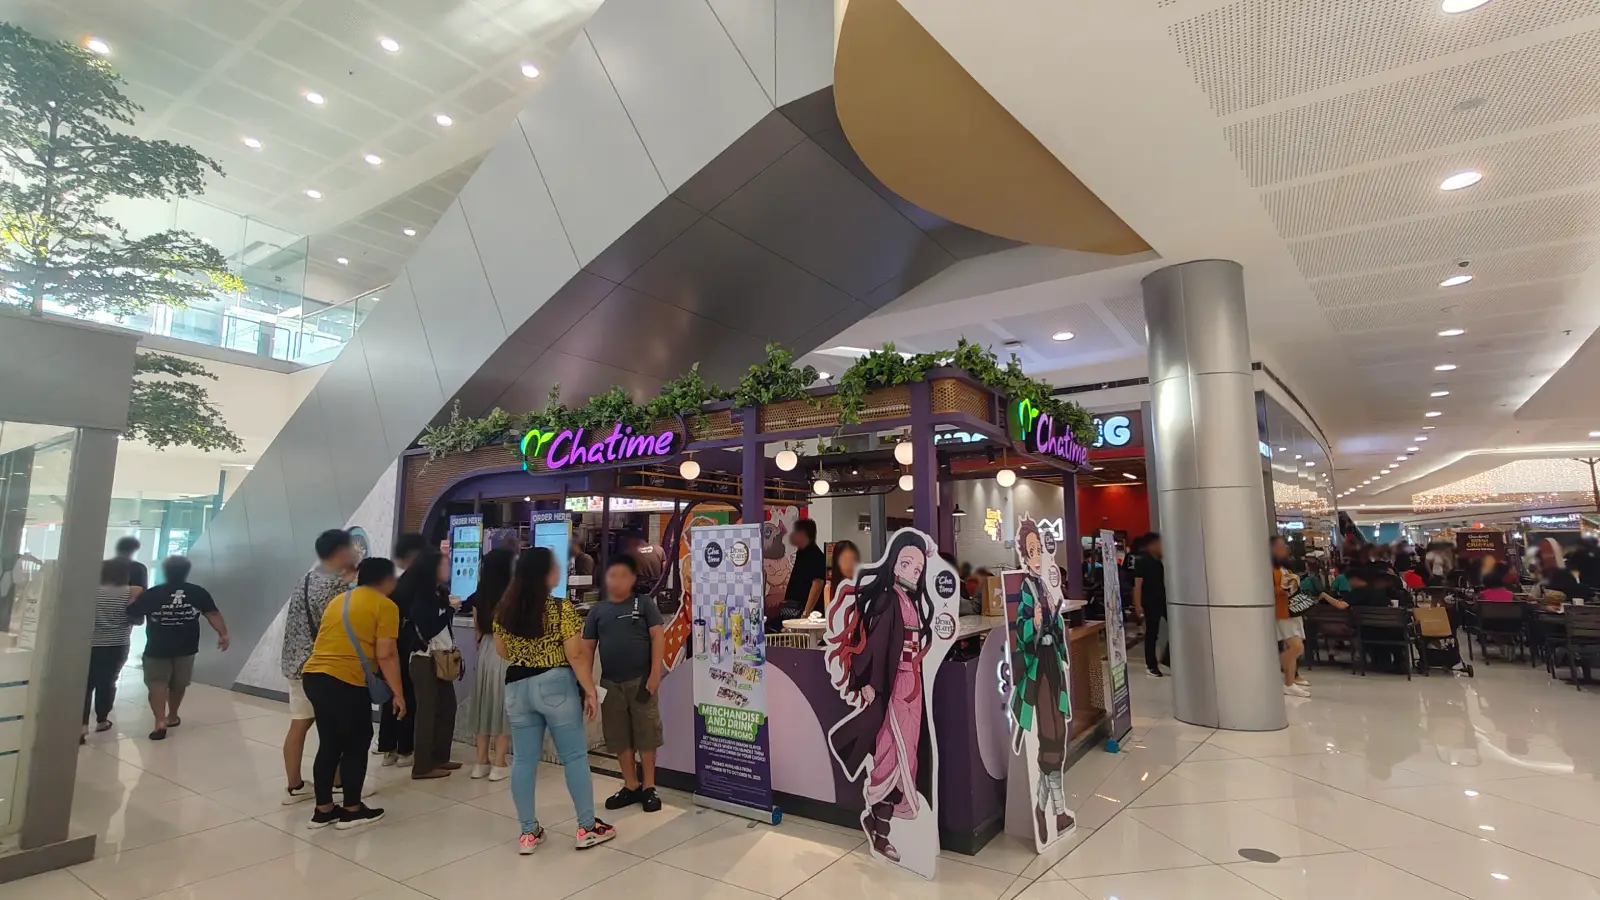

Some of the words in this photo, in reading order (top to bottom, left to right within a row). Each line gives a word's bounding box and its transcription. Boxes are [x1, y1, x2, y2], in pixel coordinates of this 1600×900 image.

[1036, 413, 1088, 465] Chatime
[546, 423, 674, 469] Chatime
[451, 517, 467, 526] ORDER
[532, 514, 553, 522] ORDER
[553, 512, 572, 520] HERE!
[707, 546, 720, 554] Cha
[938, 575, 953, 585] Cha
[938, 585, 953, 593] time
[701, 705, 760, 723] MERCHANDISE
[707, 716, 727, 727] AND
[727, 719, 754, 733] DRINK
[708, 725, 731, 736] BUNDLE
[730, 729, 754, 740] PROMO
[731, 770, 748, 778] OCTOBER
